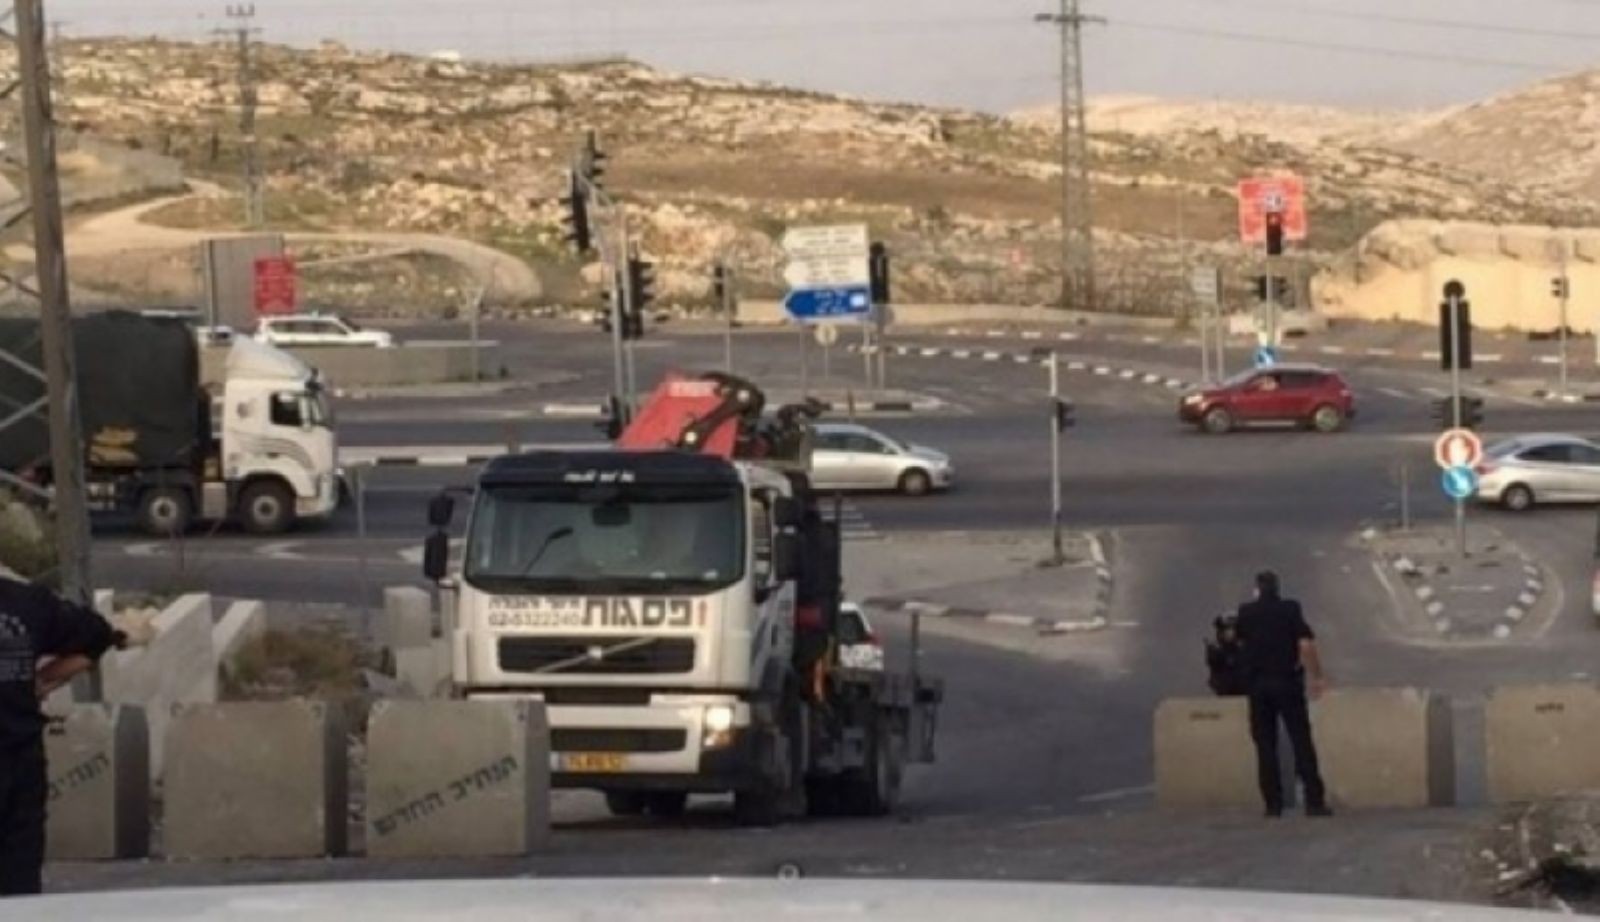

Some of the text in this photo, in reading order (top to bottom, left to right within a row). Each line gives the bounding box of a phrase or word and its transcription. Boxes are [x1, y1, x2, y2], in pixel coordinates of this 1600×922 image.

[581, 597, 692, 626] פסגות
[447, 755, 519, 802] הנתיב
[372, 790, 446, 836] החדש
